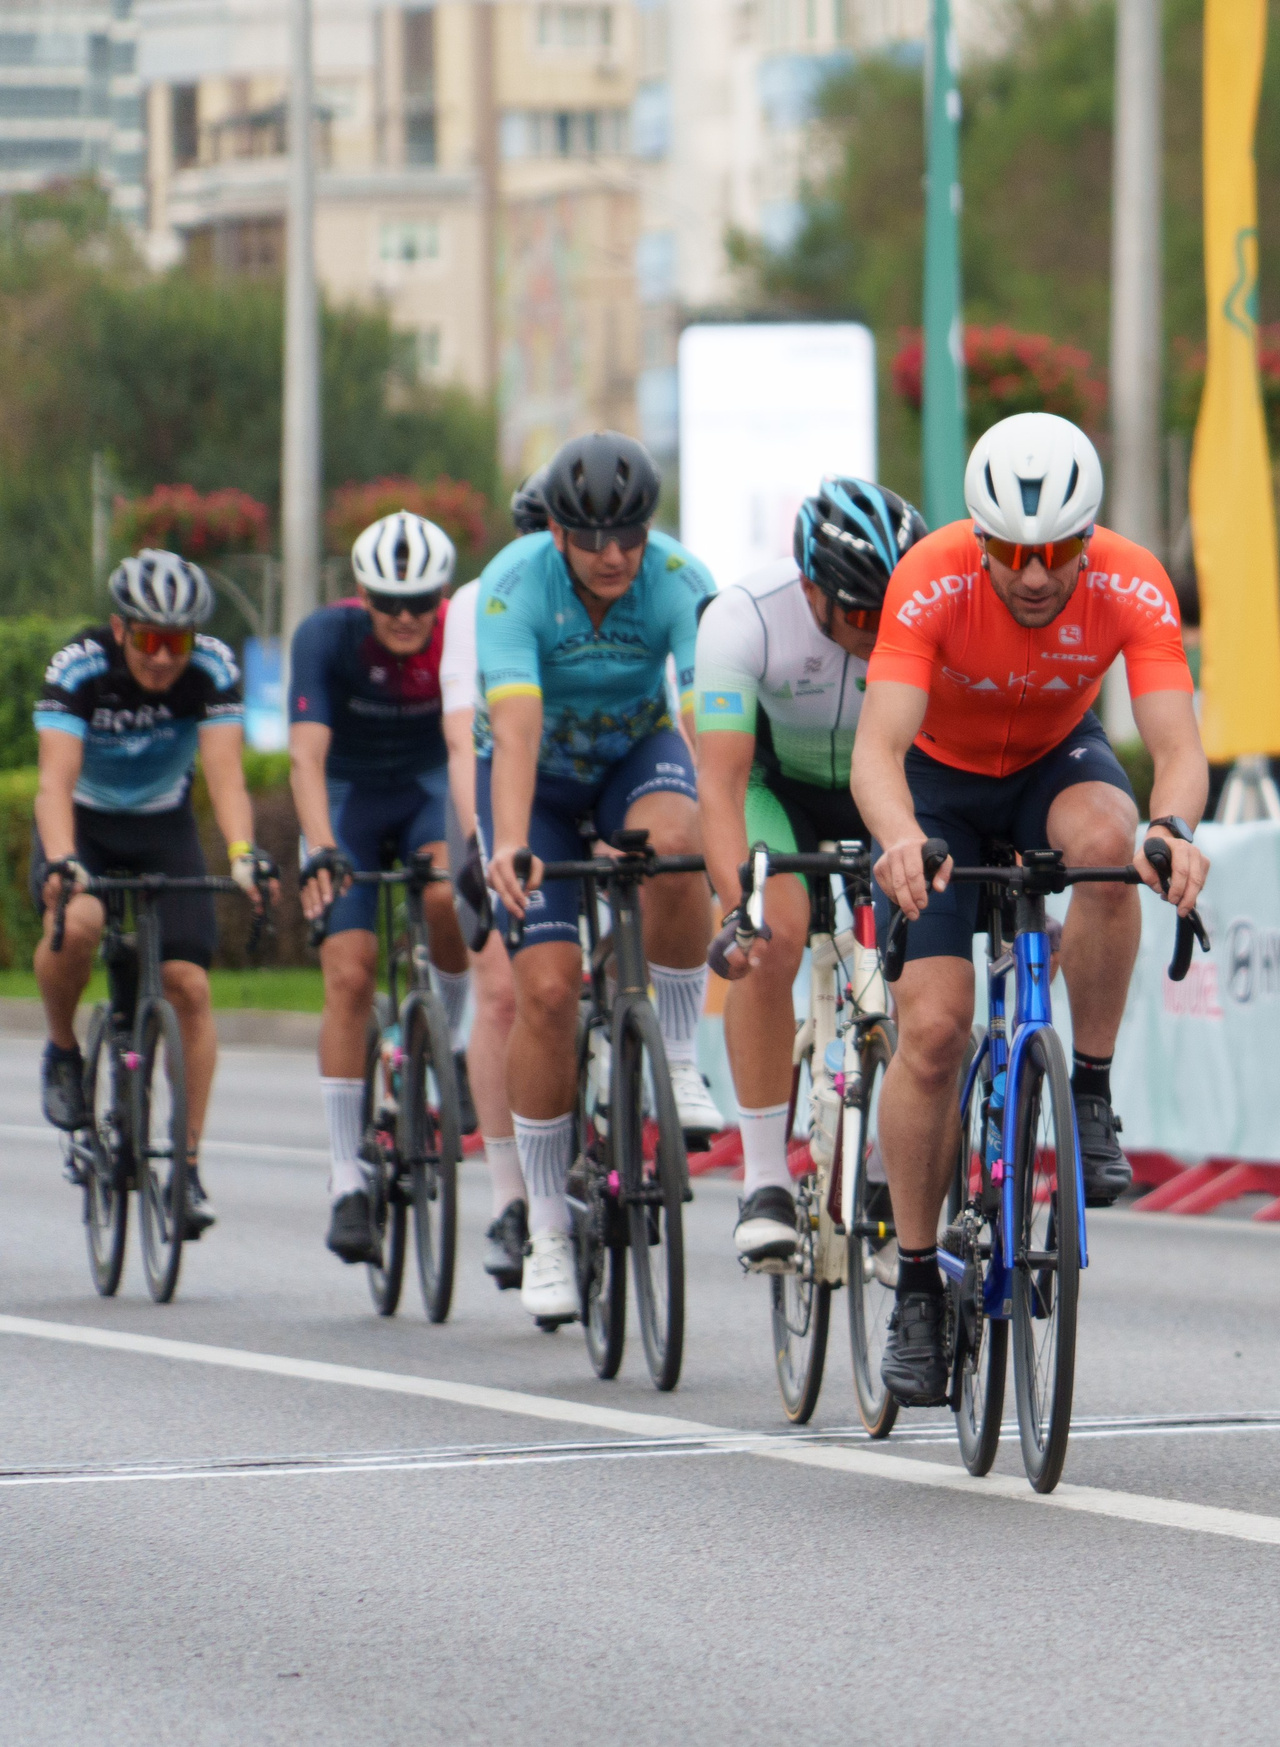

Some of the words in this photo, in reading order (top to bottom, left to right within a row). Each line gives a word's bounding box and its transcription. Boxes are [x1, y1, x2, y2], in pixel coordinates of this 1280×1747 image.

[896, 571, 979, 628] RUDY
[1086, 571, 1178, 628] RUDY
[45, 638, 105, 685] BORA
[1041, 651, 1098, 662] LOOK
